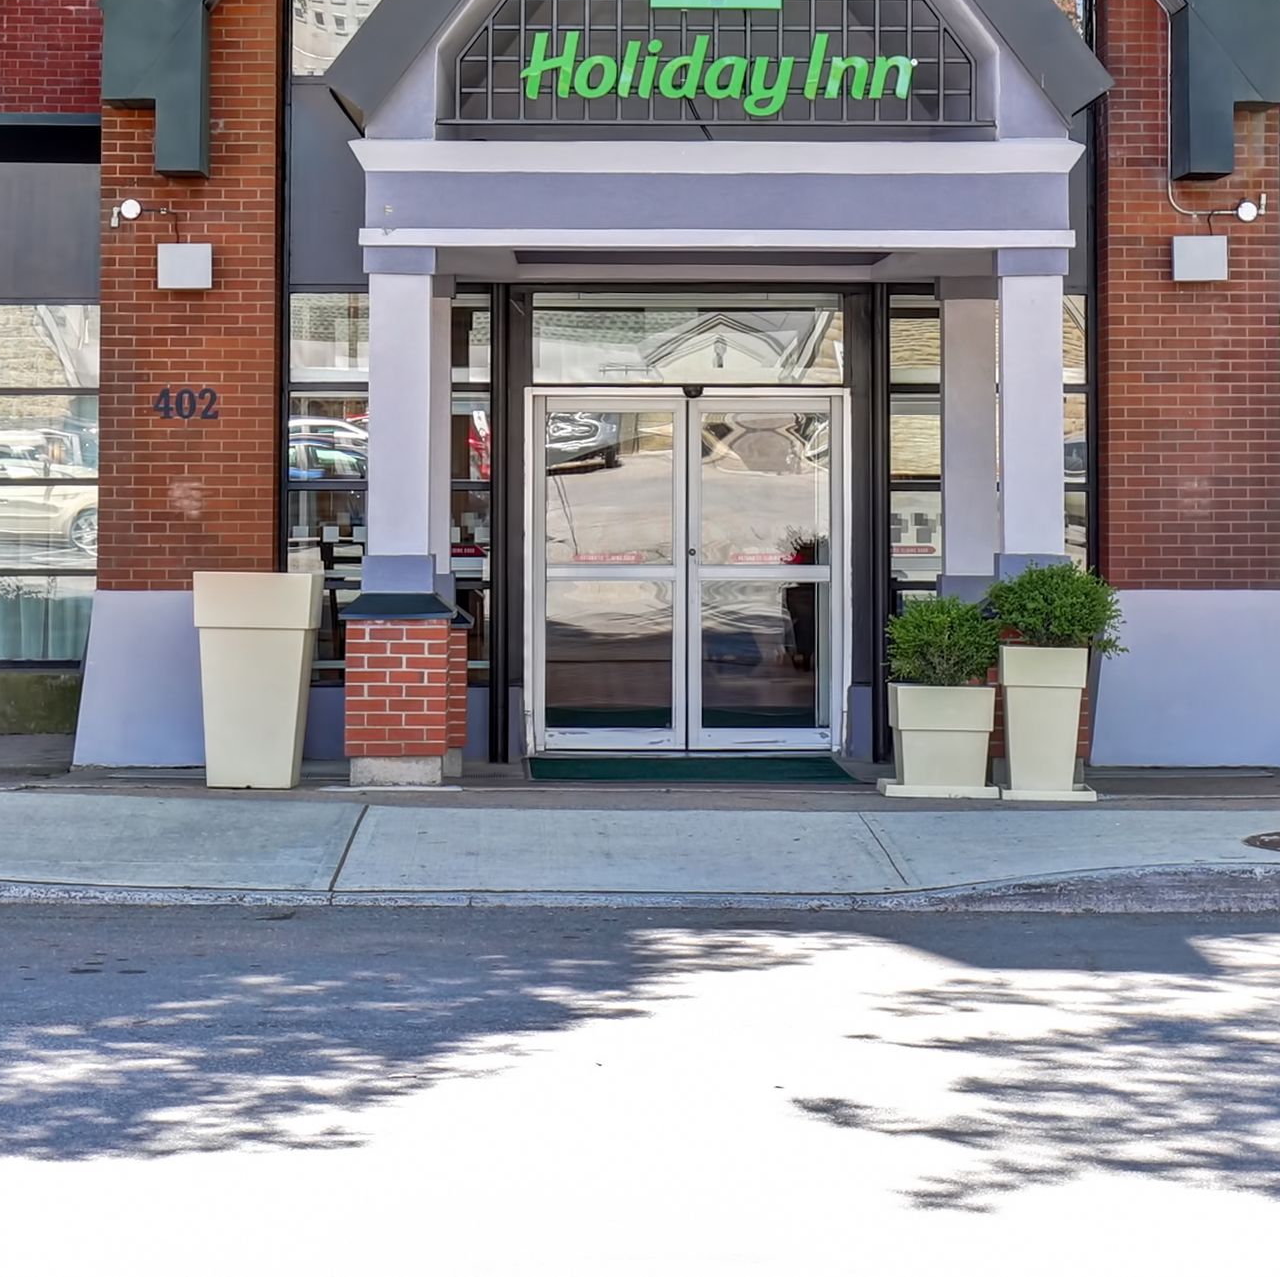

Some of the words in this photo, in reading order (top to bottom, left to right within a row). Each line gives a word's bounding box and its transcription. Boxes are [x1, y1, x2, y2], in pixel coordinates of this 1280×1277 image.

[520, 30, 796, 117] Holiday
[803, 32, 914, 101] Inn
[153, 387, 219, 419] 402
